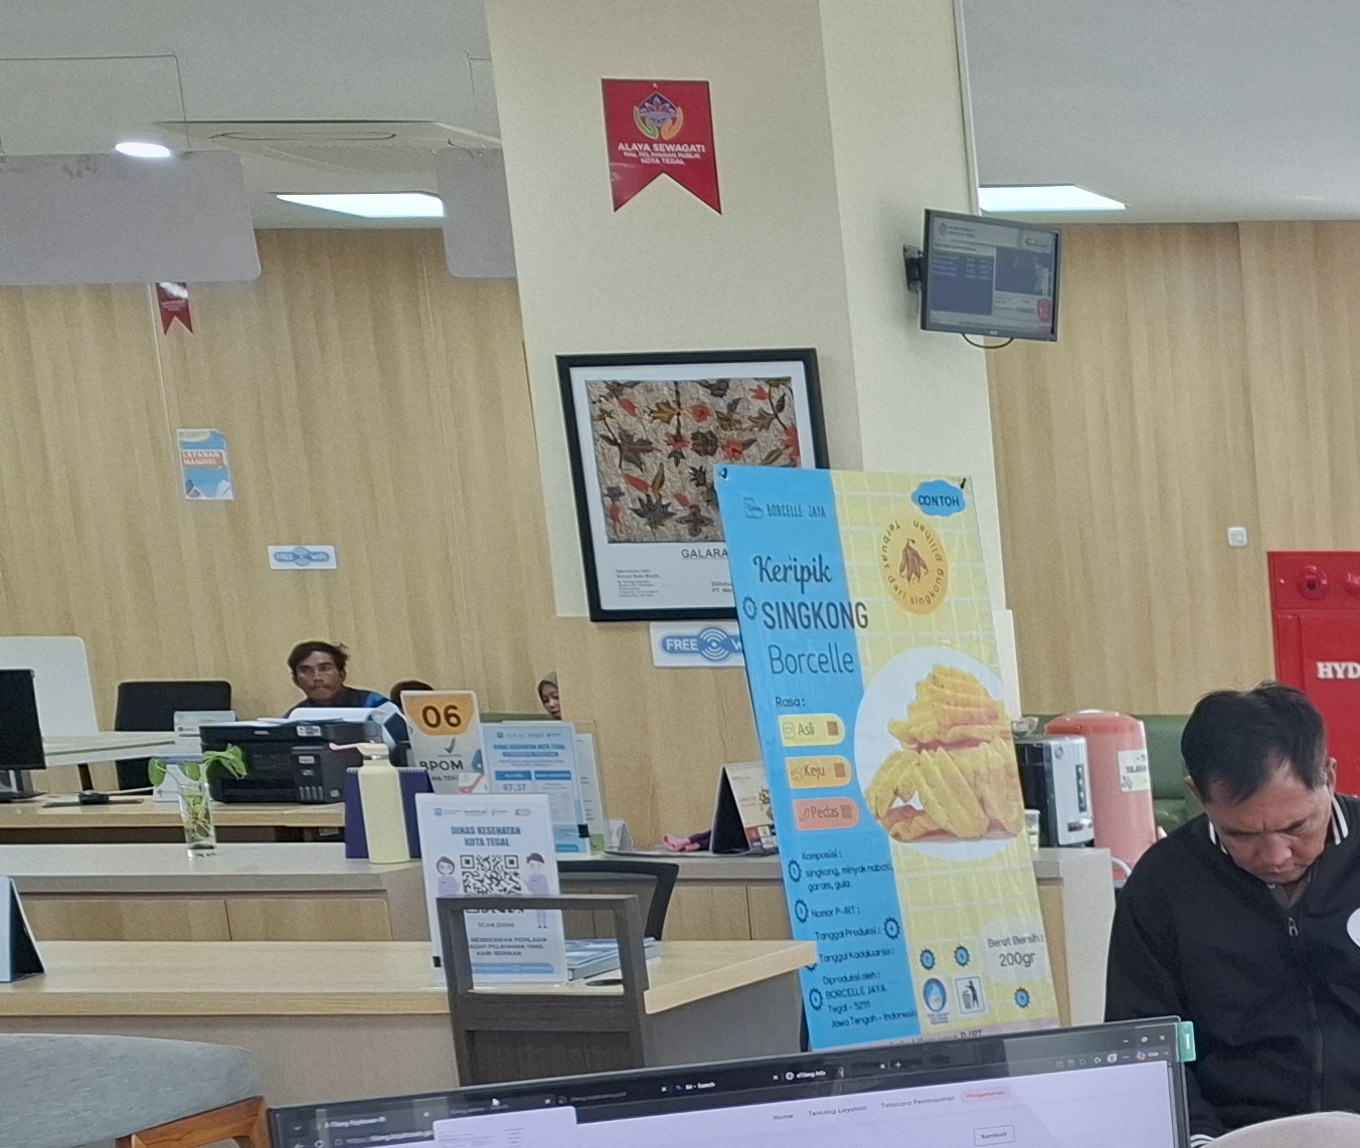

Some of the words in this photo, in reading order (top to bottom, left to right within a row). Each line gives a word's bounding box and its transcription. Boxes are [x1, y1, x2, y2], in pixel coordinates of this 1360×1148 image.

[617, 142, 652, 152] ALAYA
[652, 143, 706, 153] SEWAGATI
[661, 158, 686, 166] TEGAL
[917, 494, 961, 507] CONTOH
[767, 504, 803, 518] BORCELLE
[808, 504, 827, 518] JAYA
[752, 553, 833, 595] Keripik
[761, 600, 869, 631] SINGKONG
[665, 638, 699, 651] FREE
[767, 641, 855, 675] Borcelle
[421, 704, 462, 729] 06
[797, 721, 816, 736] Asli
[419, 759, 464, 772] BPOM
[803, 763, 826, 780] Keju
[810, 804, 840, 819] Pedas
[476, 826, 522, 835] KESEHATAN
[464, 838, 485, 846] KOTA
[486, 838, 510, 846] TEGAL
[834, 880, 851, 891] gula
[815, 930, 845, 941] Tanggal
[987, 937, 1012, 948] Berat
[819, 952, 848, 964] Tanggal
[999, 951, 1036, 968] 200gr
[825, 986, 866, 1000] BORCELLE
[867, 984, 888, 994] JAYA
[828, 1003, 848, 1014] Tegal
